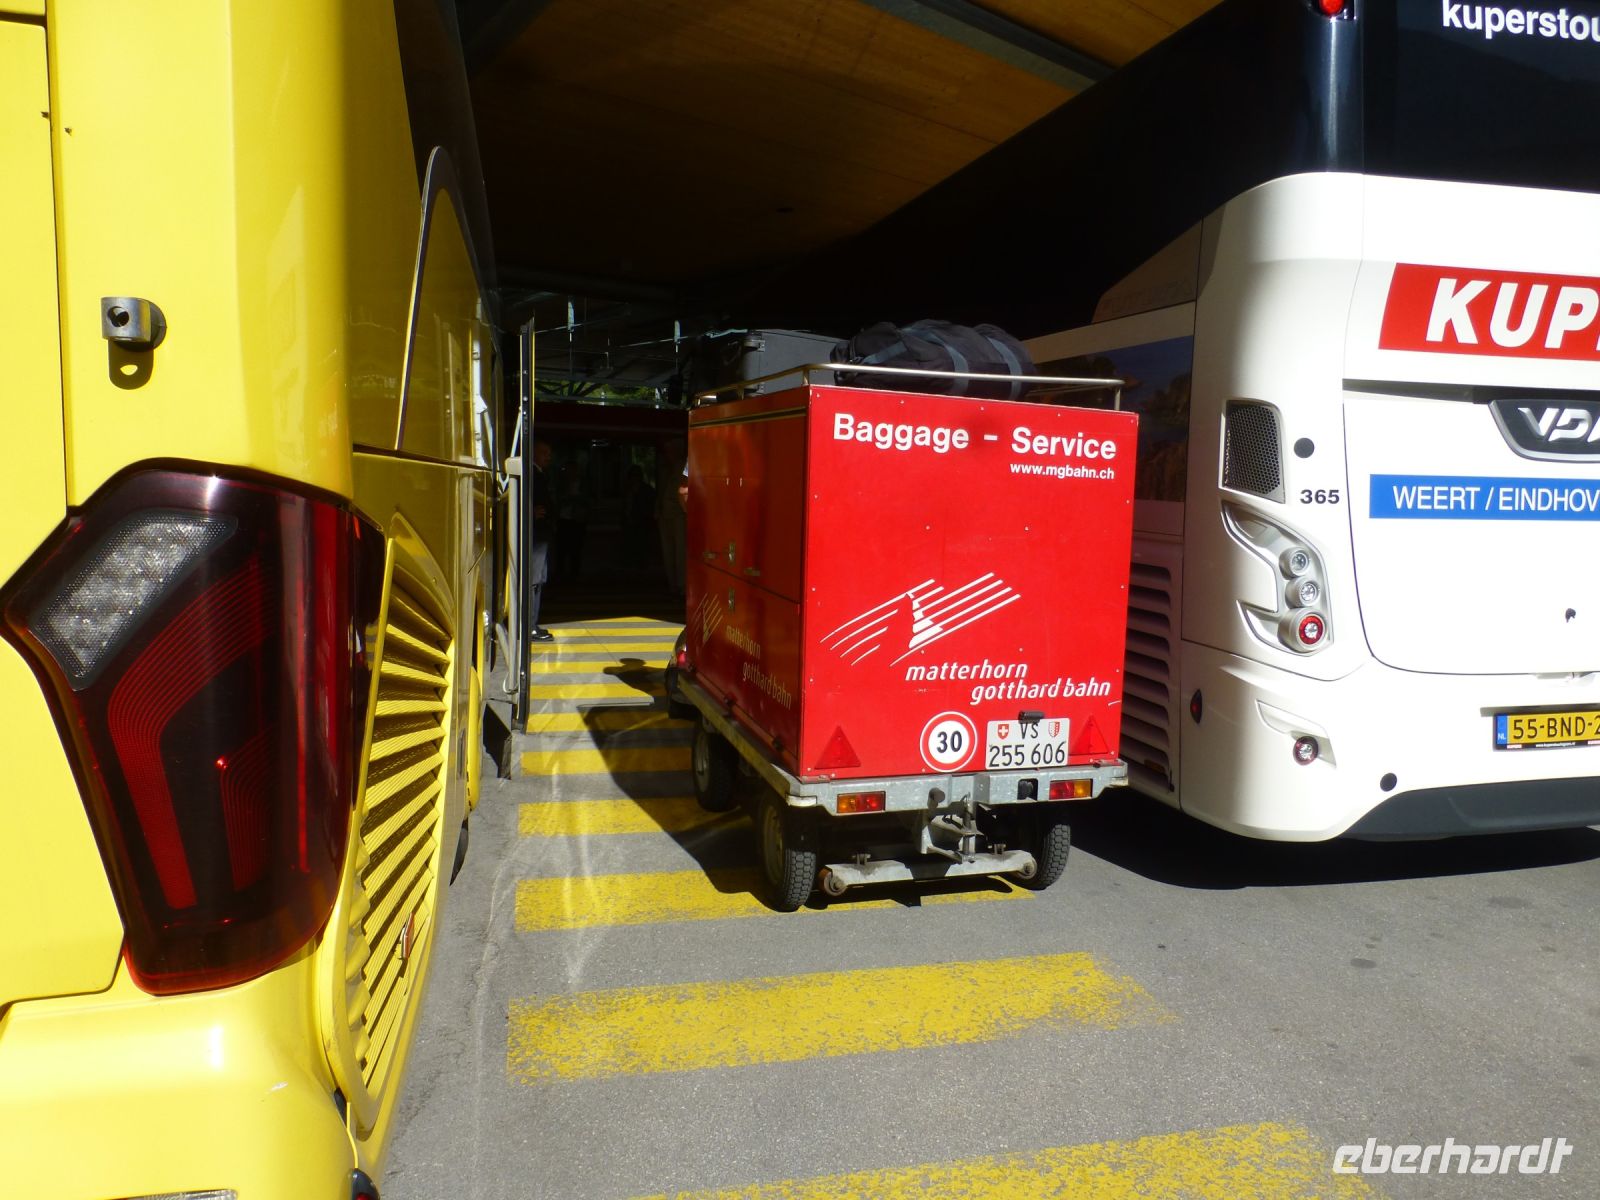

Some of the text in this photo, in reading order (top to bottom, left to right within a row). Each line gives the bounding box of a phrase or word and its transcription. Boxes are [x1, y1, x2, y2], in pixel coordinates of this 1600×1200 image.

[1426, 277, 1600, 351] KUP
[833, 412, 969, 453] Baggage
[1011, 426, 1117, 460] Service
[1518, 407, 1600, 443] VD
[1010, 461, 1115, 480] www.mgbahn.ch
[1300, 489, 1340, 505] 365
[1392, 485, 1480, 510] WEERT
[1499, 487, 1600, 512] EINDHOV
[726, 624, 761, 660] matterhorn
[905, 659, 1028, 681] matterhorn
[970, 677, 1111, 706] gotthard bahn
[936, 730, 963, 754] 30
[1019, 722, 1039, 740] VS
[1497, 732, 1507, 740] NL
[988, 741, 1066, 767] 255 606
